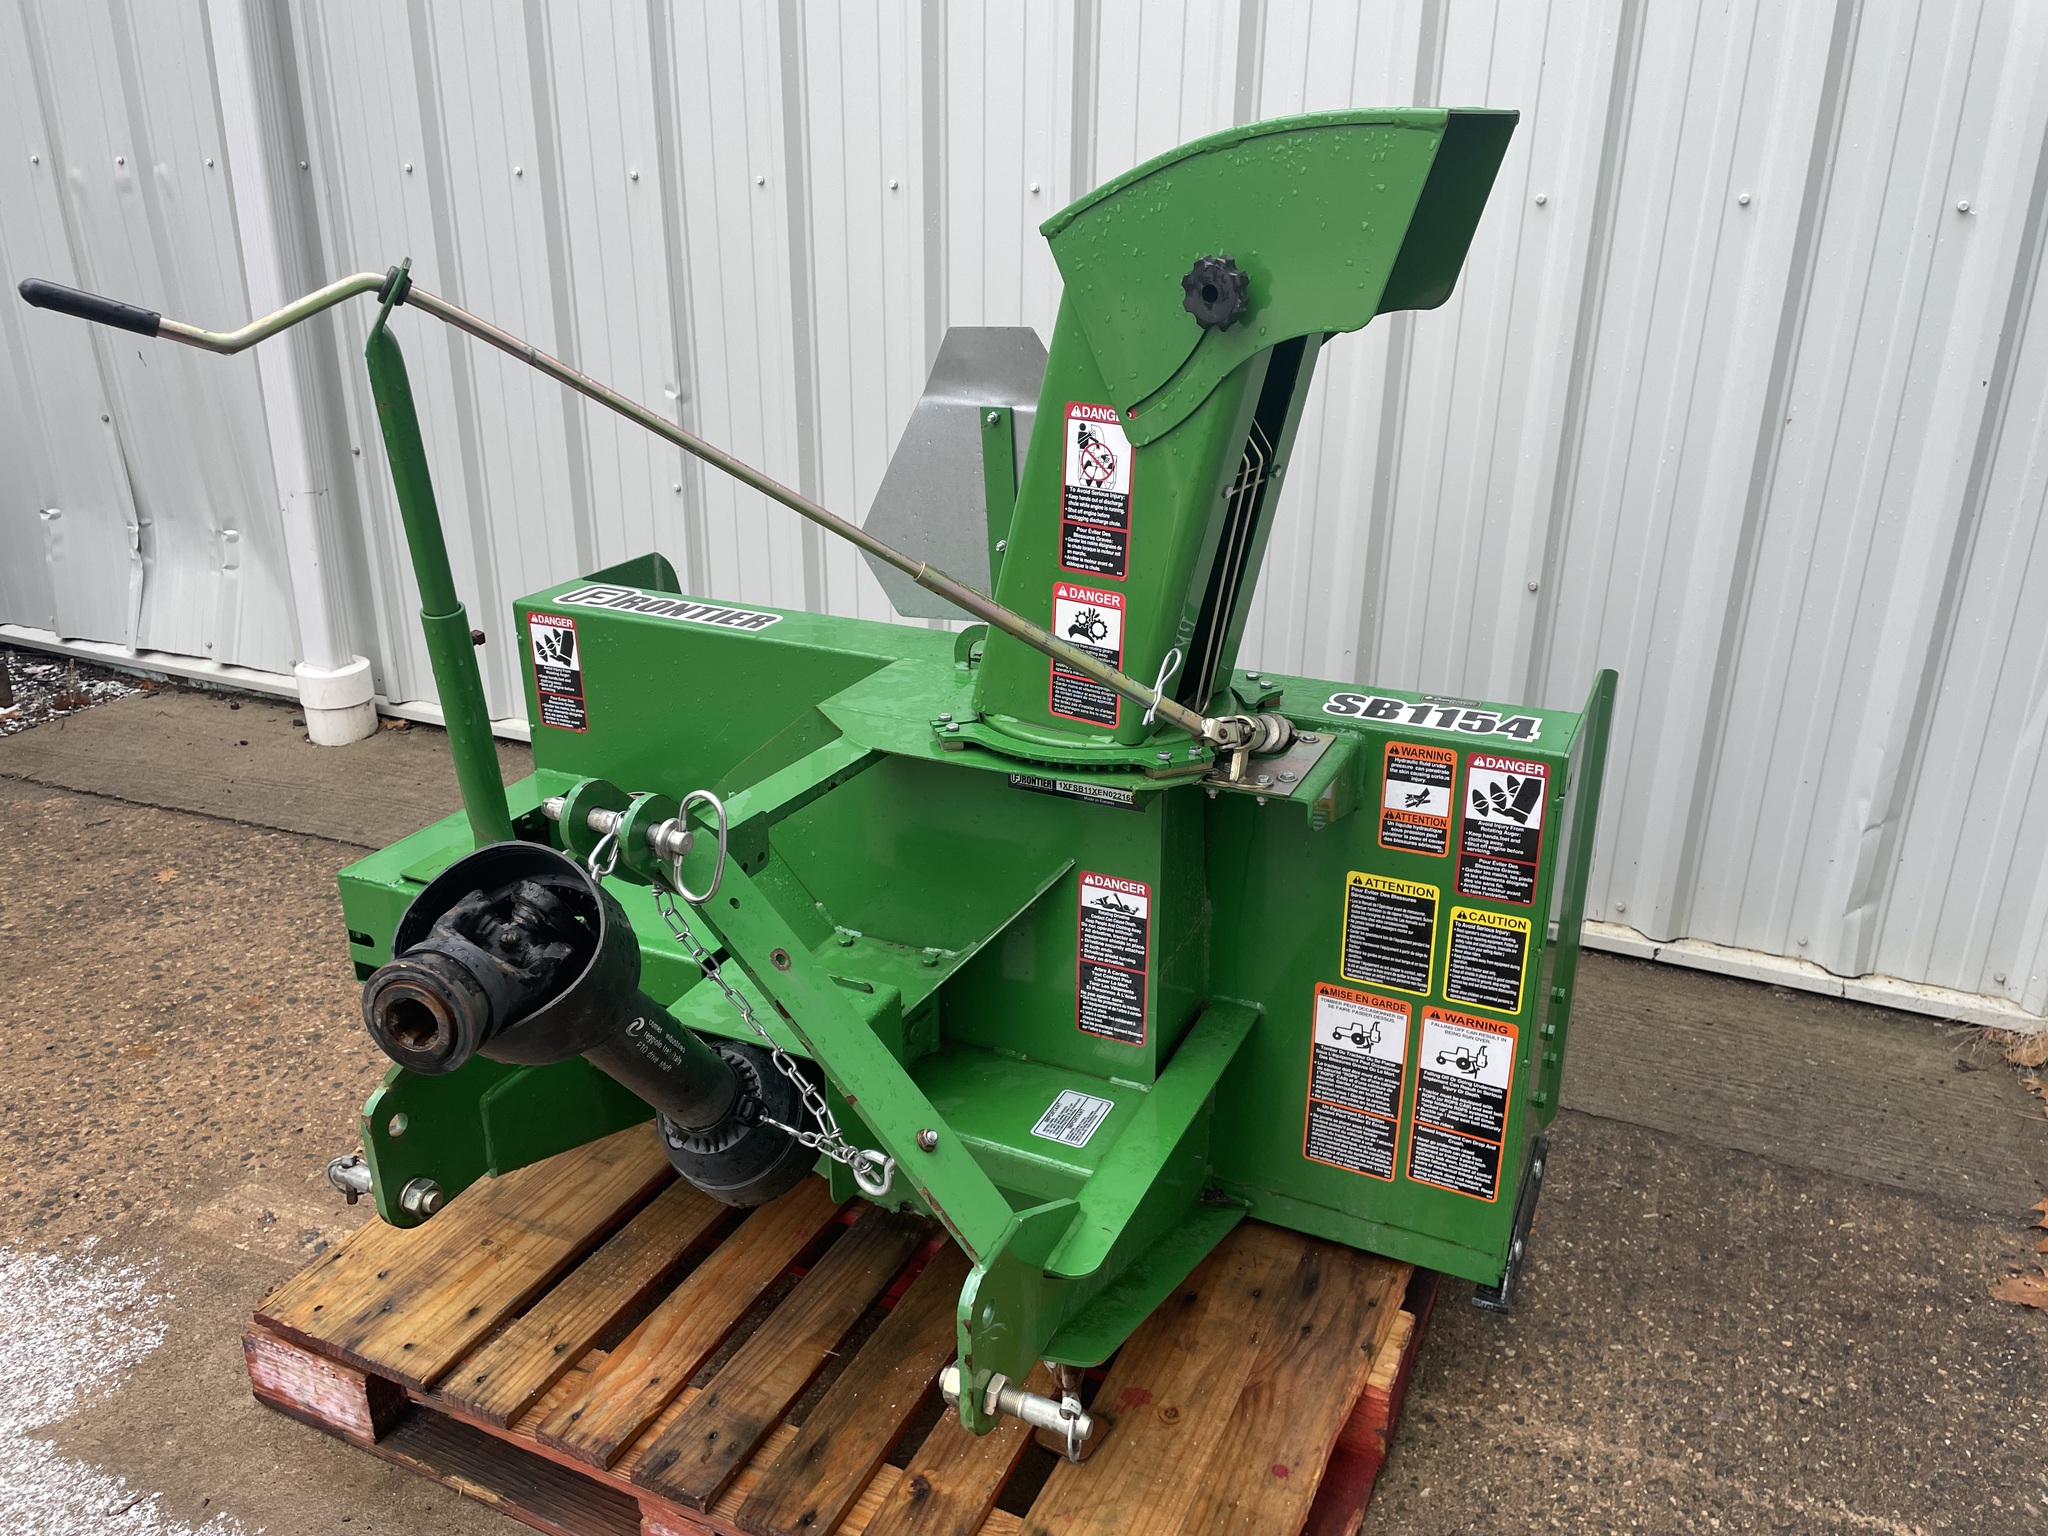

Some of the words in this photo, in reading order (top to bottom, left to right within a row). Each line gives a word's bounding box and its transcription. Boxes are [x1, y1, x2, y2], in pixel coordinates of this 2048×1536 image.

[1082, 406, 1119, 421] DANG
[1069, 587, 1120, 607] DANGER
[559, 586, 778, 629] FRONTIER
[538, 614, 573, 628] DANGER
[1326, 694, 1536, 740] SB1154
[1401, 746, 1452, 762] WARNING
[1486, 757, 1544, 775] DANGER
[1011, 774, 1052, 789] FRONTIER
[1395, 813, 1447, 828] ATTENTION
[1094, 876, 1145, 895] DANGER
[1365, 878, 1434, 898] ATTENTION
[1469, 911, 1527, 930] CAUTION
[1321, 997, 1342, 1006] TOMBER
[1330, 987, 1352, 1000] MISE
[1356, 994, 1368, 1004] EN
[1372, 998, 1406, 1012] GARDE
[1352, 1009, 1372, 1018] PASSER
[1431, 1022, 1453, 1030] FALLING
[1479, 1033, 1499, 1041] RESULT
[1445, 1013, 1508, 1035] WARNING
[636, 1041, 648, 1054] PTO
[659, 1061, 672, 1072] shaft
